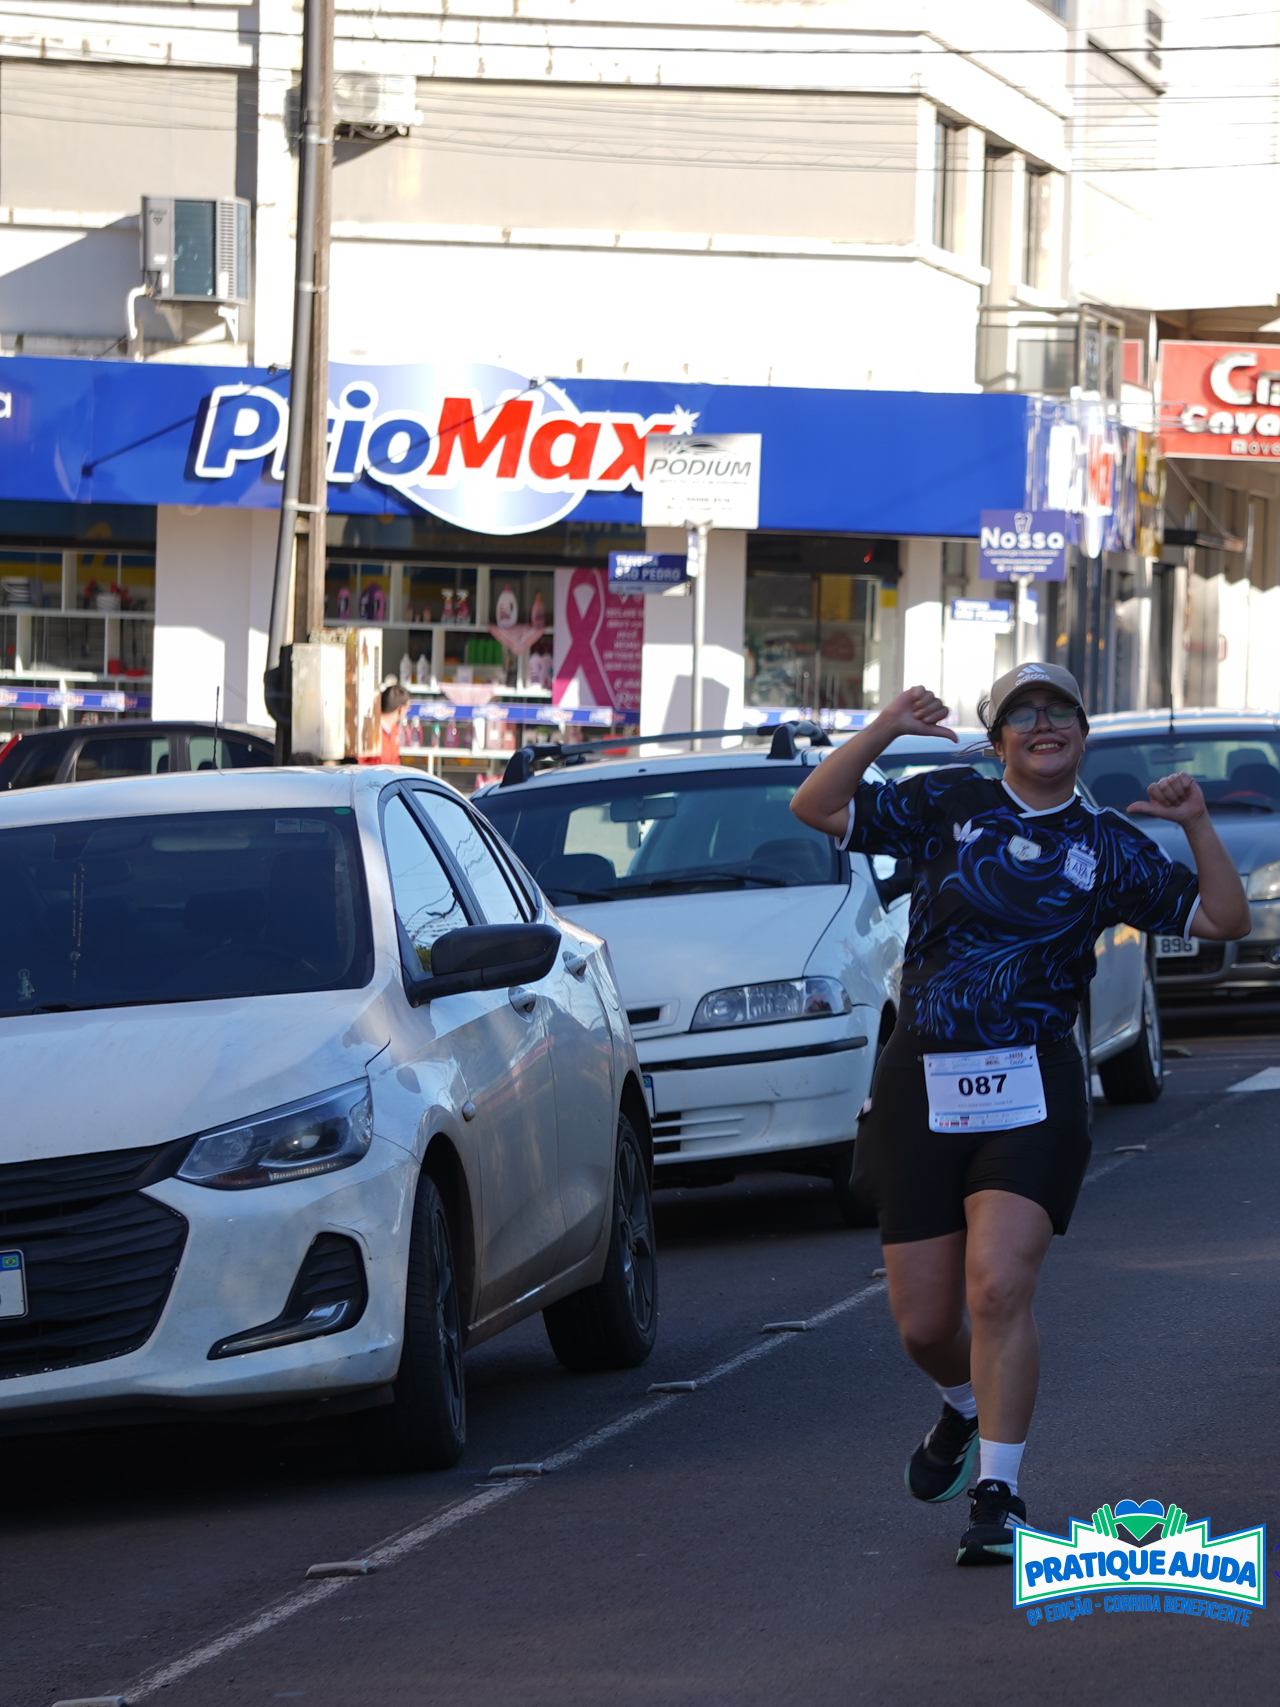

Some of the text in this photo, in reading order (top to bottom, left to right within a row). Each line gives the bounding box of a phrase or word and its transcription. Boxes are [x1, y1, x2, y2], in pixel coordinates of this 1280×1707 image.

[198, 383, 677, 488] PioMax
[648, 458, 752, 477] PODIUM
[980, 527, 1065, 549] Nossa
[641, 568, 682, 581] PEDRO
[1015, 673, 1051, 686] adidas
[958, 1073, 1008, 1096] 087
